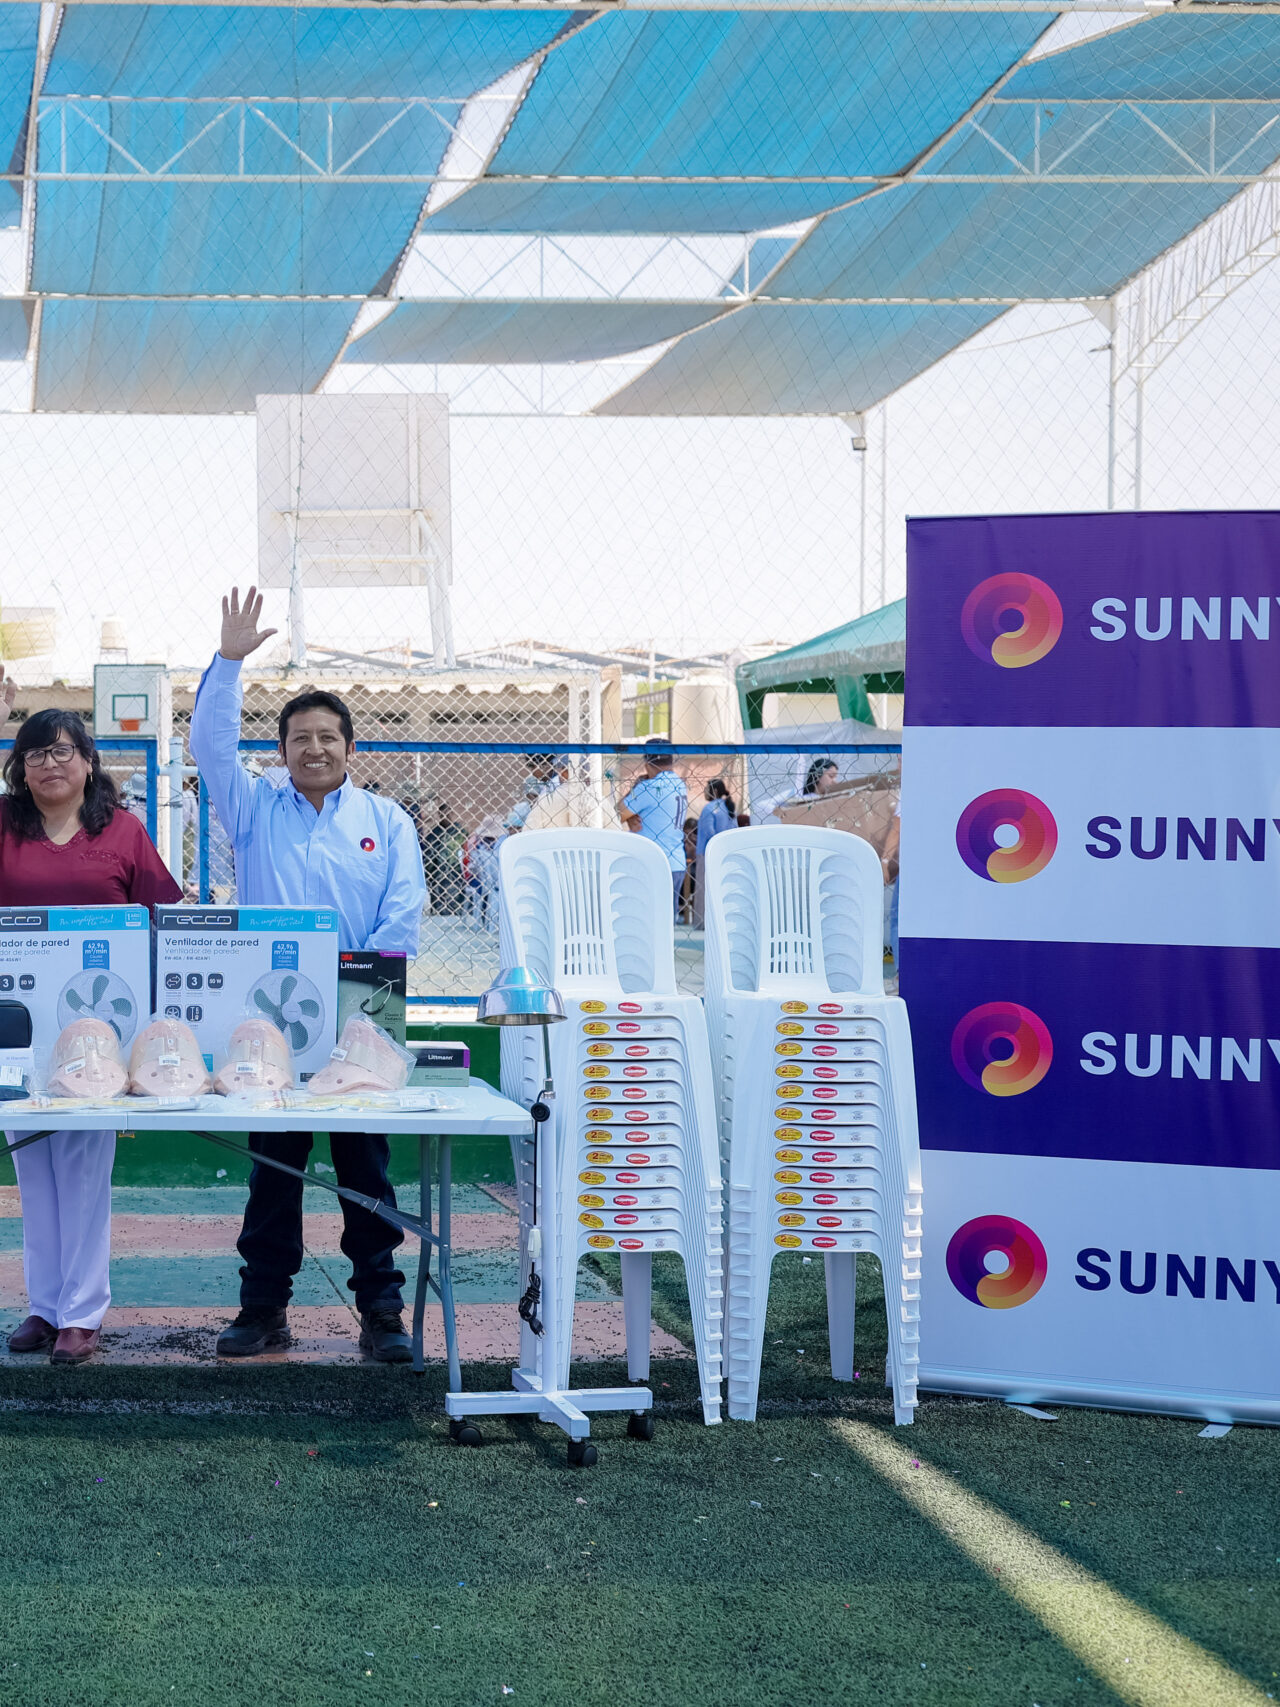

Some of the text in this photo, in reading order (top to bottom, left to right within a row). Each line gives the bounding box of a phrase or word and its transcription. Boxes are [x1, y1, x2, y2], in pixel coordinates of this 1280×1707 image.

[1090, 597, 1280, 641] SUNN
[1086, 816, 1280, 861] SUNN
[25, 938, 39, 947] de
[41, 938, 70, 948] pared
[165, 937, 259, 948] Ventilador de pared
[2, 978, 9, 988] 3
[191, 976, 198, 986] 3
[592, 1044, 599, 1052] 2
[589, 1087, 596, 1095] 2
[590, 1130, 597, 1138] 2
[583, 1194, 590, 1202] 2
[582, 1213, 591, 1221] 2
[783, 1214, 790, 1222] 2
